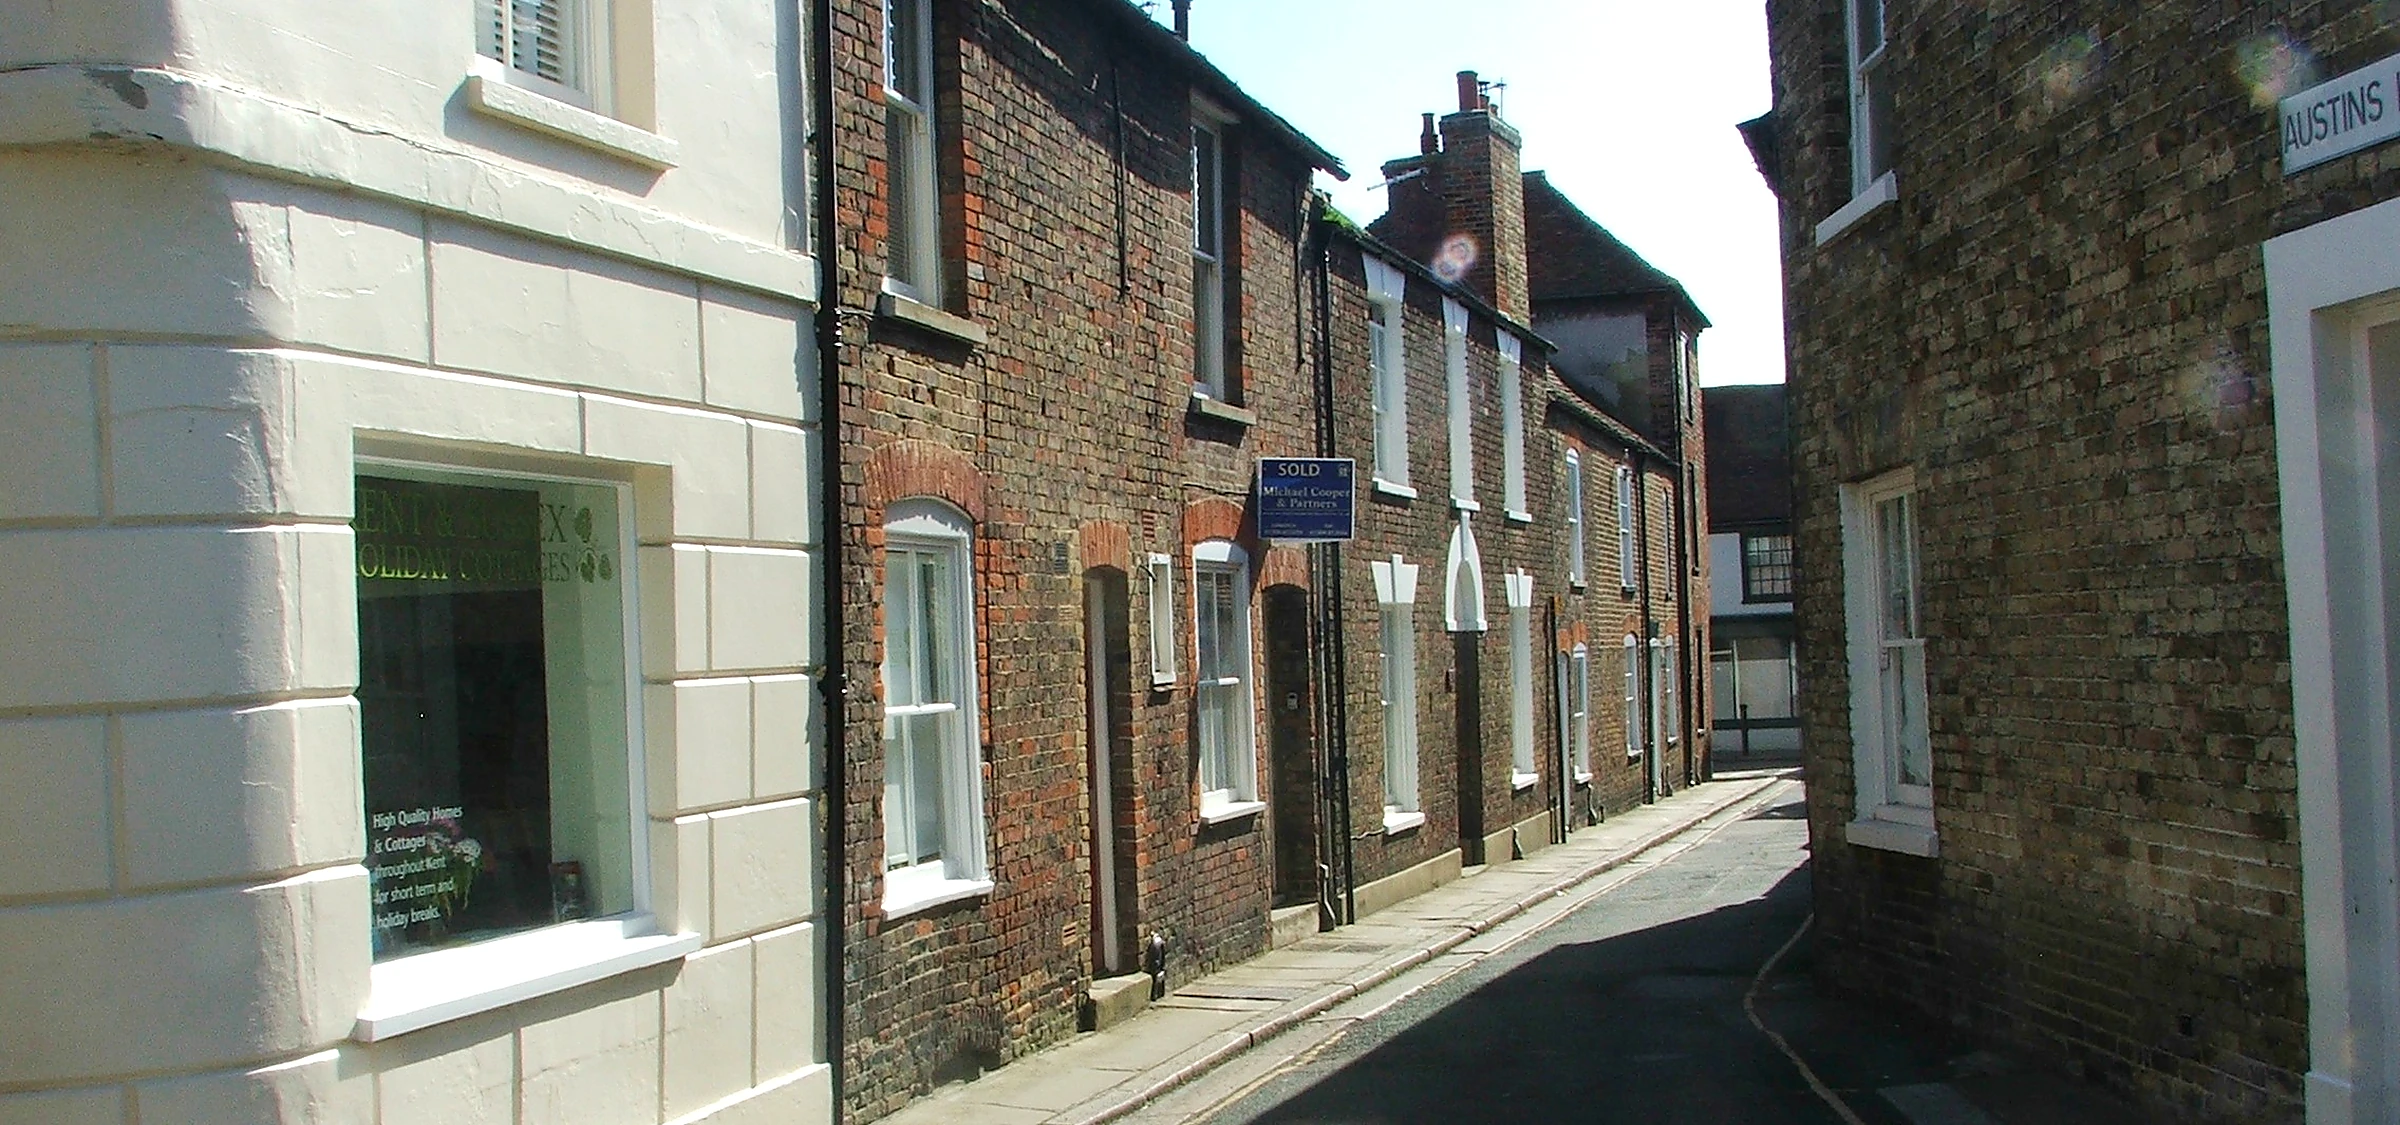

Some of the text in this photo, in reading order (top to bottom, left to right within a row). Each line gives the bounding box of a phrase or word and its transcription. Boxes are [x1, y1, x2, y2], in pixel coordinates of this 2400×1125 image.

[2284, 81, 2383, 154] AUSTINS
[1278, 463, 1320, 476] SOLD
[1263, 487, 1350, 498] Michael Cooper
[1276, 498, 1337, 508] & Partners
[352, 489, 426, 535] ENT
[357, 543, 448, 579] OLIDAY
[373, 806, 463, 831] High Quality Homes
[374, 836, 426, 853] & Cottages
[375, 856, 446, 879] throughout Kent
[374, 877, 454, 904] for short term and
[377, 912, 409, 929] holiday
